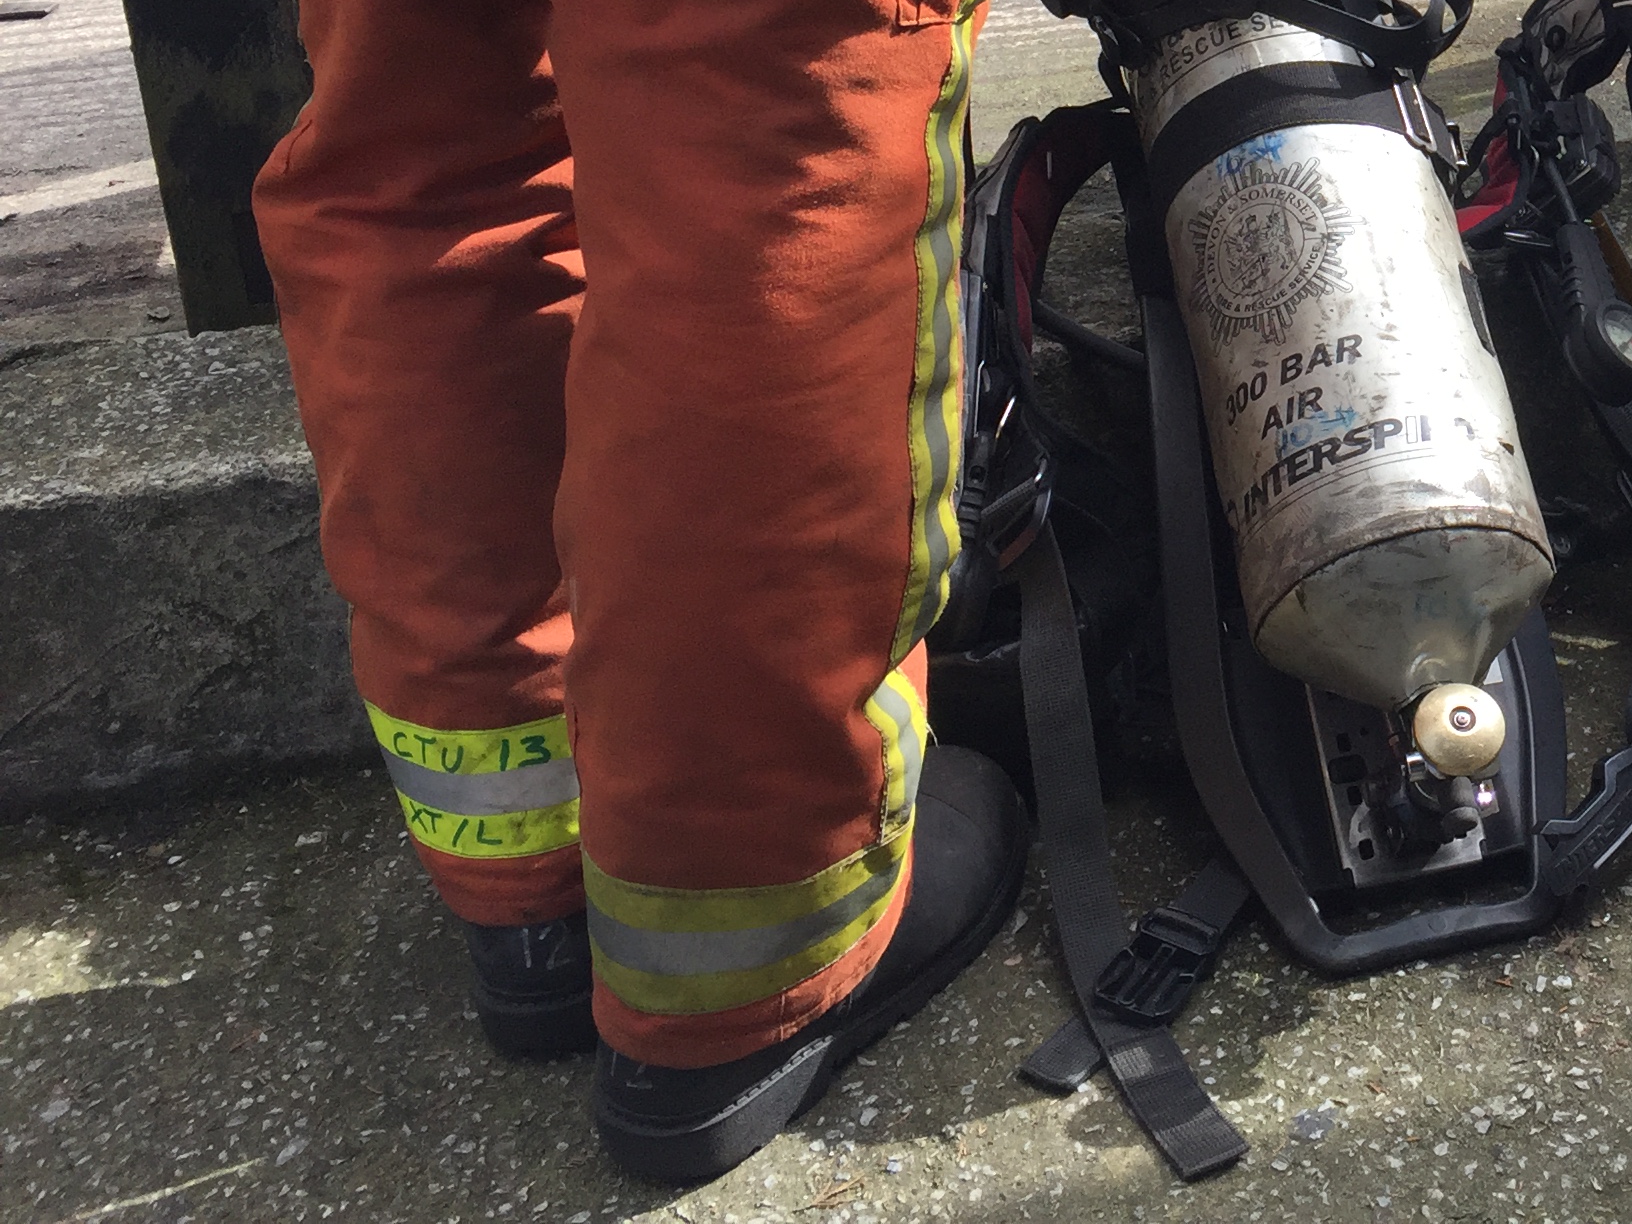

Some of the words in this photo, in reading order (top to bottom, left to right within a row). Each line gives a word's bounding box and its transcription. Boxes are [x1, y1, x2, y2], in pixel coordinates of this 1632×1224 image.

[1159, 21, 1241, 80] RESCUE
[1207, 214, 1227, 275] DEVON
[1239, 186, 1319, 222] SOMERSET
[1244, 289, 1288, 312] RESCUE
[1288, 244, 1321, 290] SERVICE
[1226, 372, 1268, 426] 300
[1279, 334, 1364, 387] BAR
[1261, 386, 1324, 441] AIR
[393, 731, 464, 774] CTU
[499, 735, 552, 772] 13
